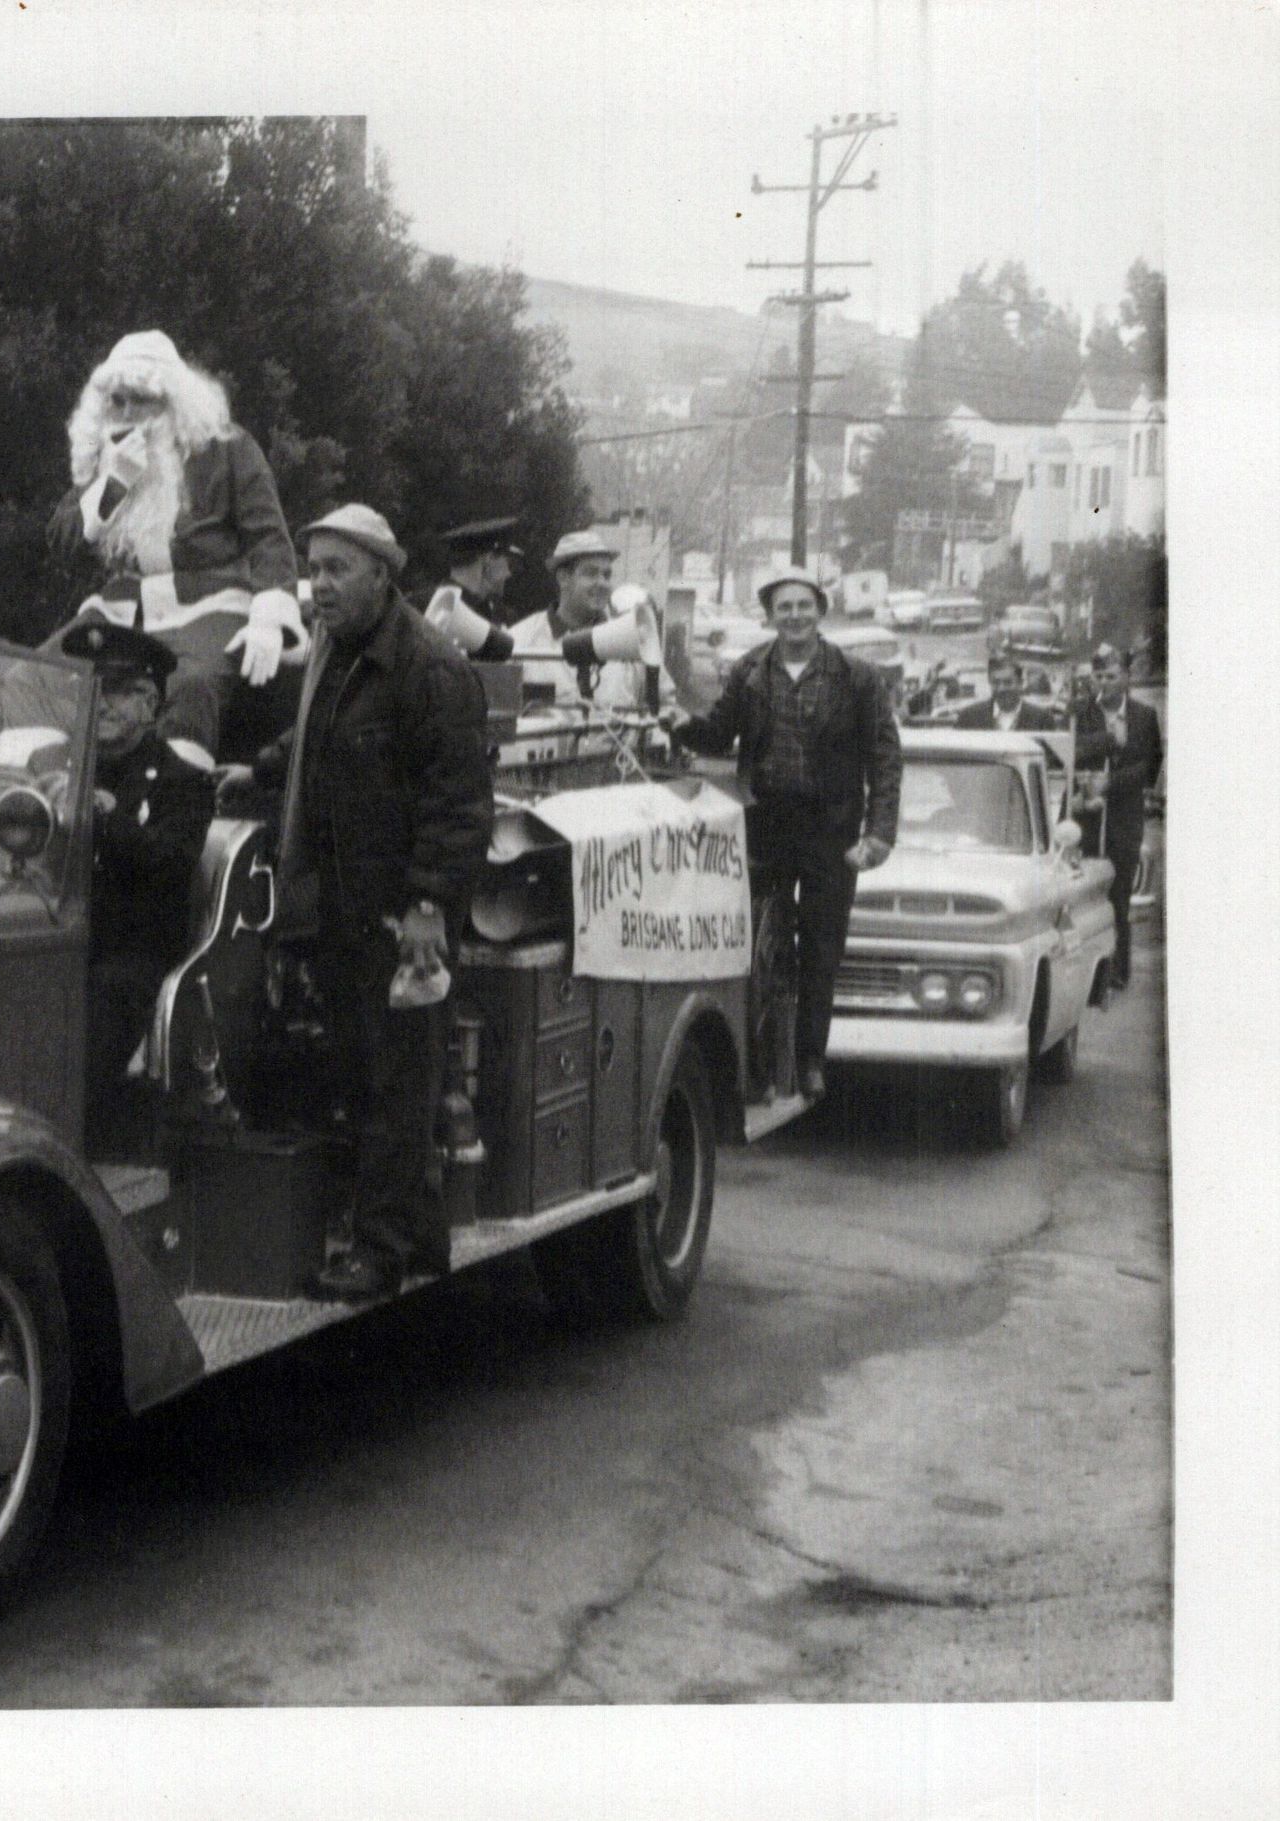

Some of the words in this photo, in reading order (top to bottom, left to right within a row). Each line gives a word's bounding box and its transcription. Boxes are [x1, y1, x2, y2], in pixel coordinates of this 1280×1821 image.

[579, 836, 643, 934] Merry
[621, 909, 685, 951] BRISBANE
[722, 912, 746, 949] CLUB
